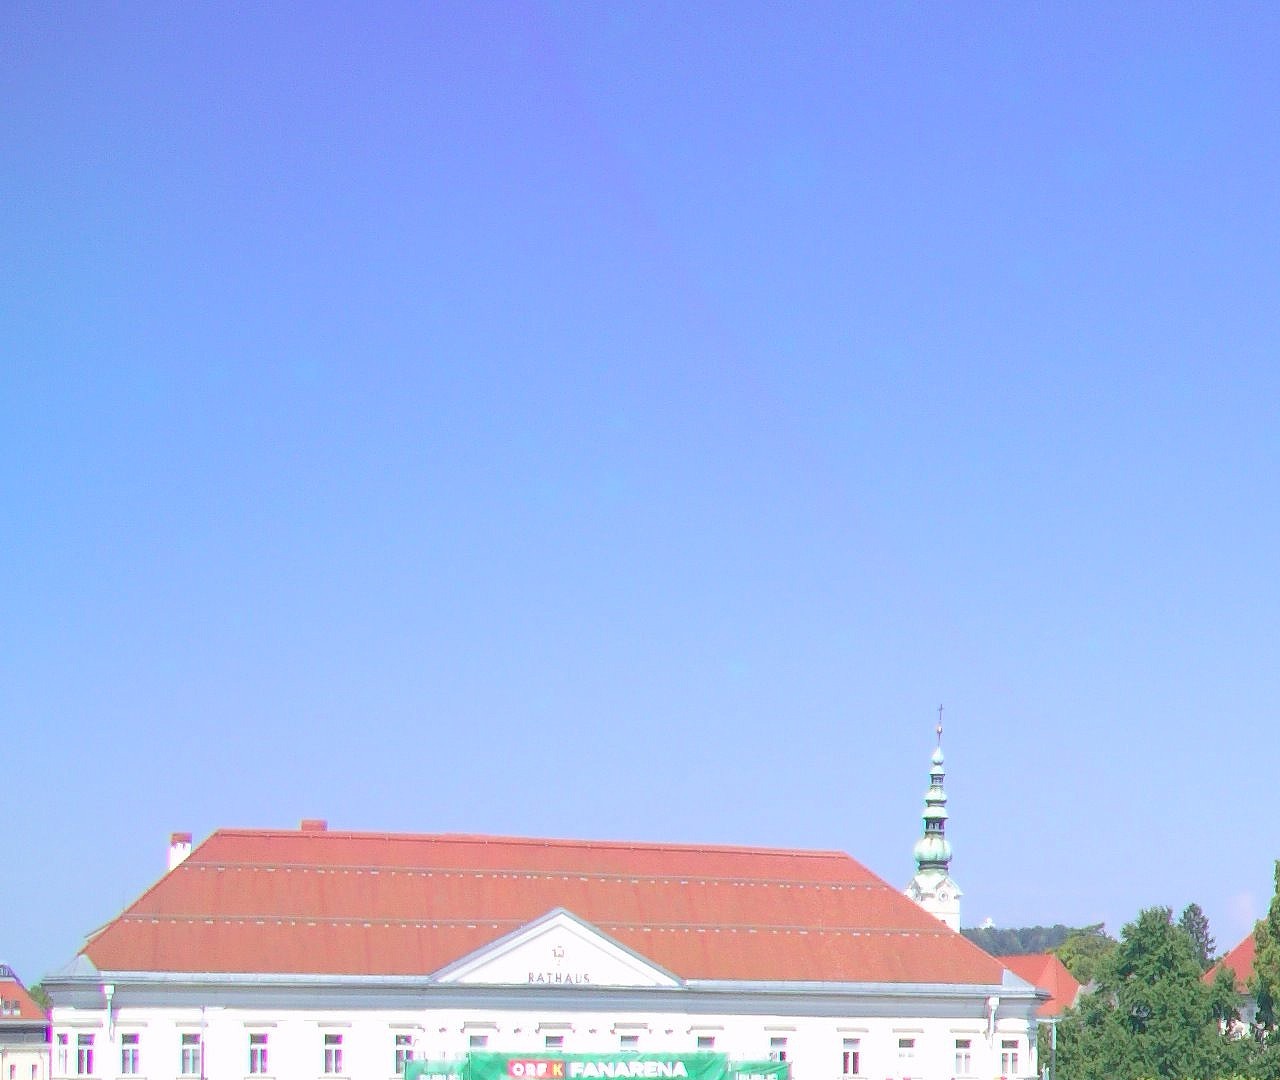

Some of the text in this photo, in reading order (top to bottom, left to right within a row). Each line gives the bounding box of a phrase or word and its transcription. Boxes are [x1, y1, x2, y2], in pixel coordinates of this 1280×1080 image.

[528, 972, 591, 984] RATHAUS
[512, 1061, 689, 1078] ORF K FANARENA
